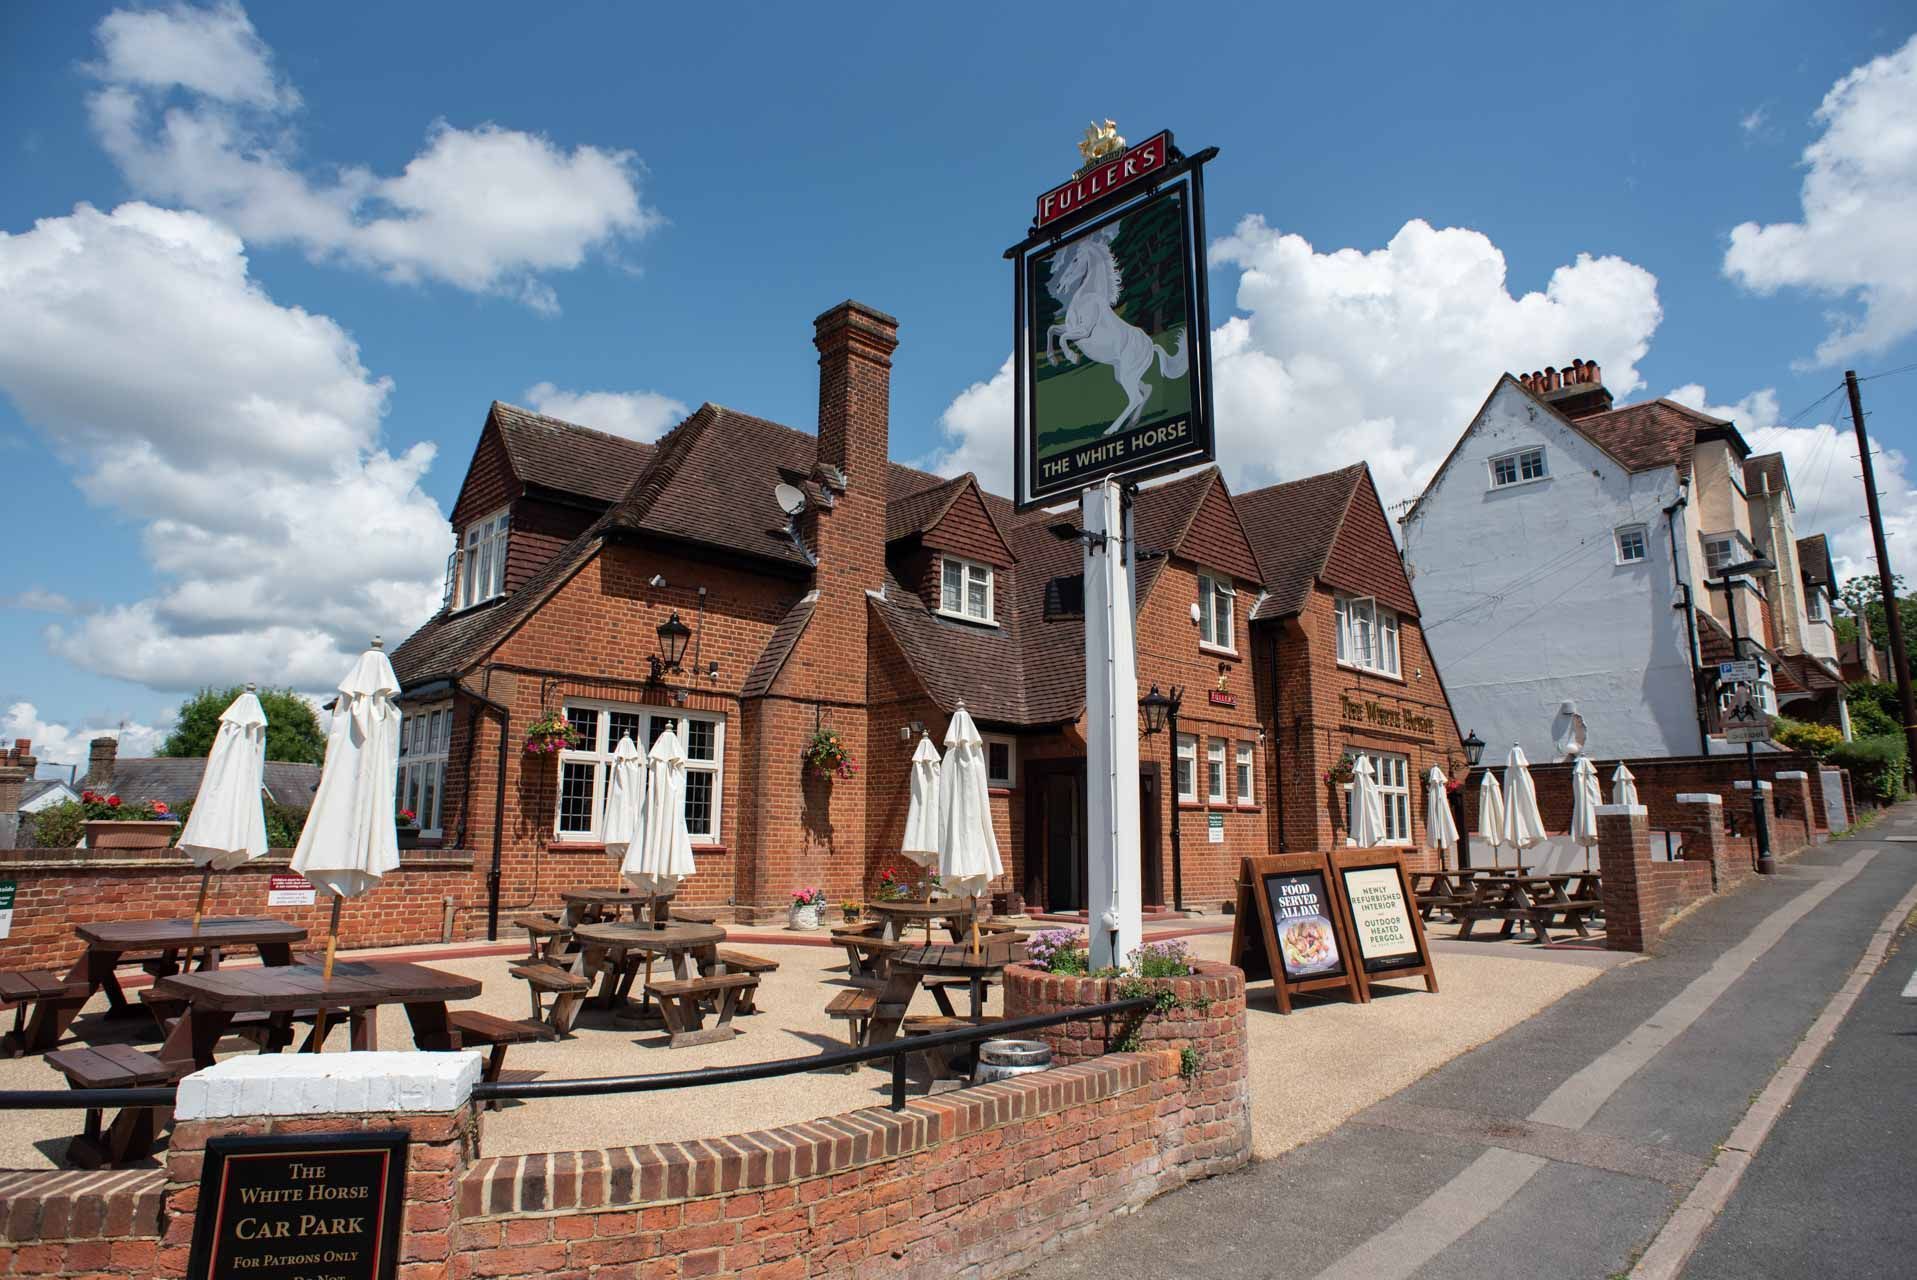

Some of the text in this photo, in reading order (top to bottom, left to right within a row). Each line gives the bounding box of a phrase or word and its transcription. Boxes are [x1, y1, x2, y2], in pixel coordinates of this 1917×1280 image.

[1044, 146, 1156, 217] FULLER'S
[1043, 420, 1187, 477] THE WHITE HORSE
[1281, 884, 1310, 896] FOOD
[1362, 886, 1386, 895] NEWLY
[1279, 894, 1318, 907] SERVED
[1351, 893, 1402, 904] REFURBISHED
[1281, 904, 1320, 918] ALL DAY
[1361, 901, 1396, 911] INTERIOR
[1364, 917, 1401, 927] OUTDOOR
[1371, 926, 1399, 935] HEATED
[1370, 934, 1404, 943] PERGOLA
[289, 1163, 326, 1179] THE
[240, 1184, 369, 1204] WHITE HORSE
[235, 1215, 365, 1240] CAR PARK
[233, 1250, 359, 1269] FOR PATRONS ONLY
